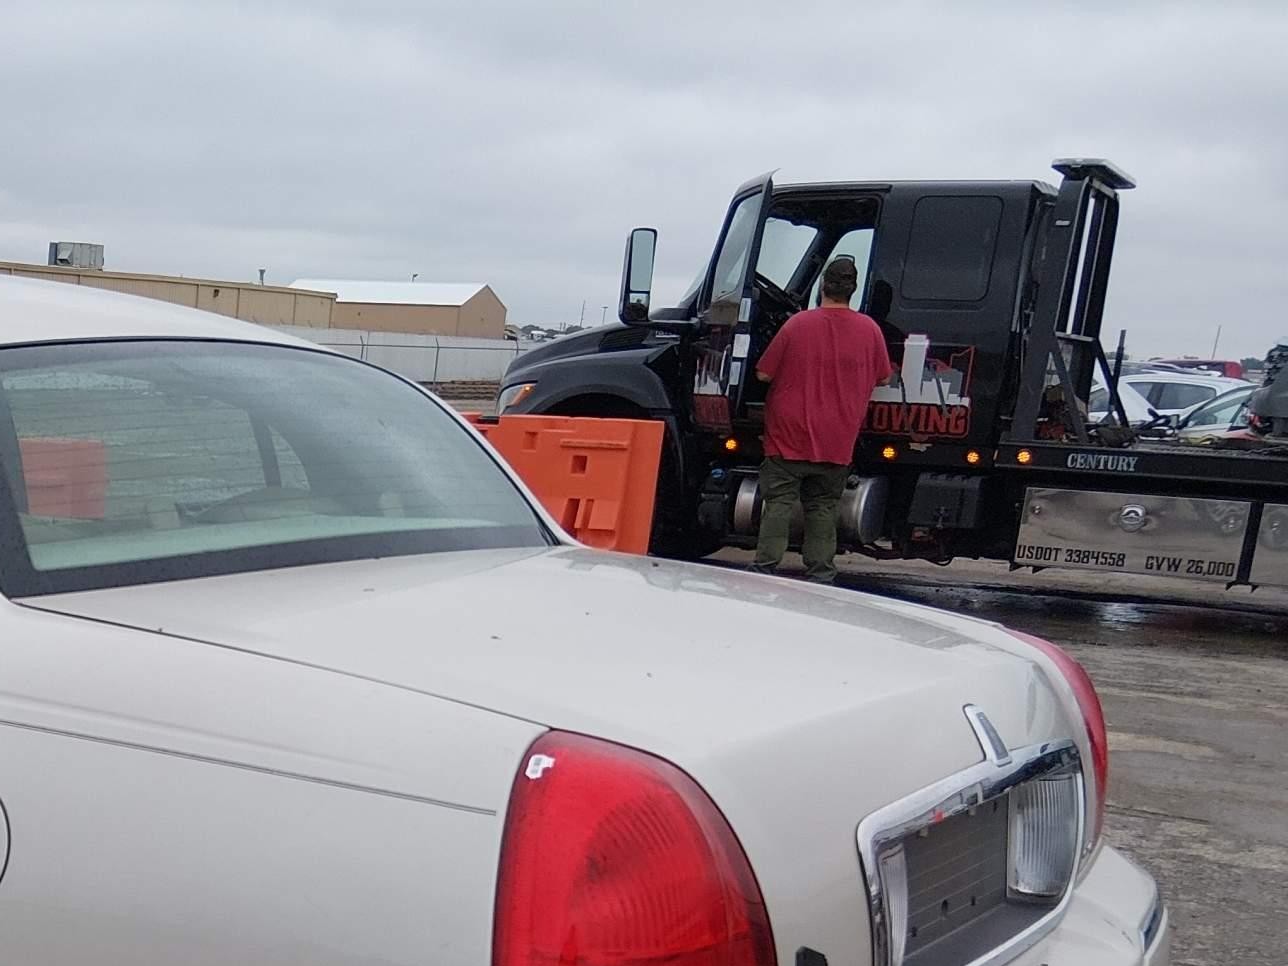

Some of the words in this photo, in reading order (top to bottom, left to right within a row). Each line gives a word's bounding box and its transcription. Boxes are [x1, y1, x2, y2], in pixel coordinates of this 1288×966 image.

[1067, 453, 1138, 471] CENTURY
[1016, 544, 1062, 561] USDOT
[1064, 548, 1127, 567] 3384558
[1145, 555, 1183, 572] GVW
[1186, 559, 1235, 577] 26,000
